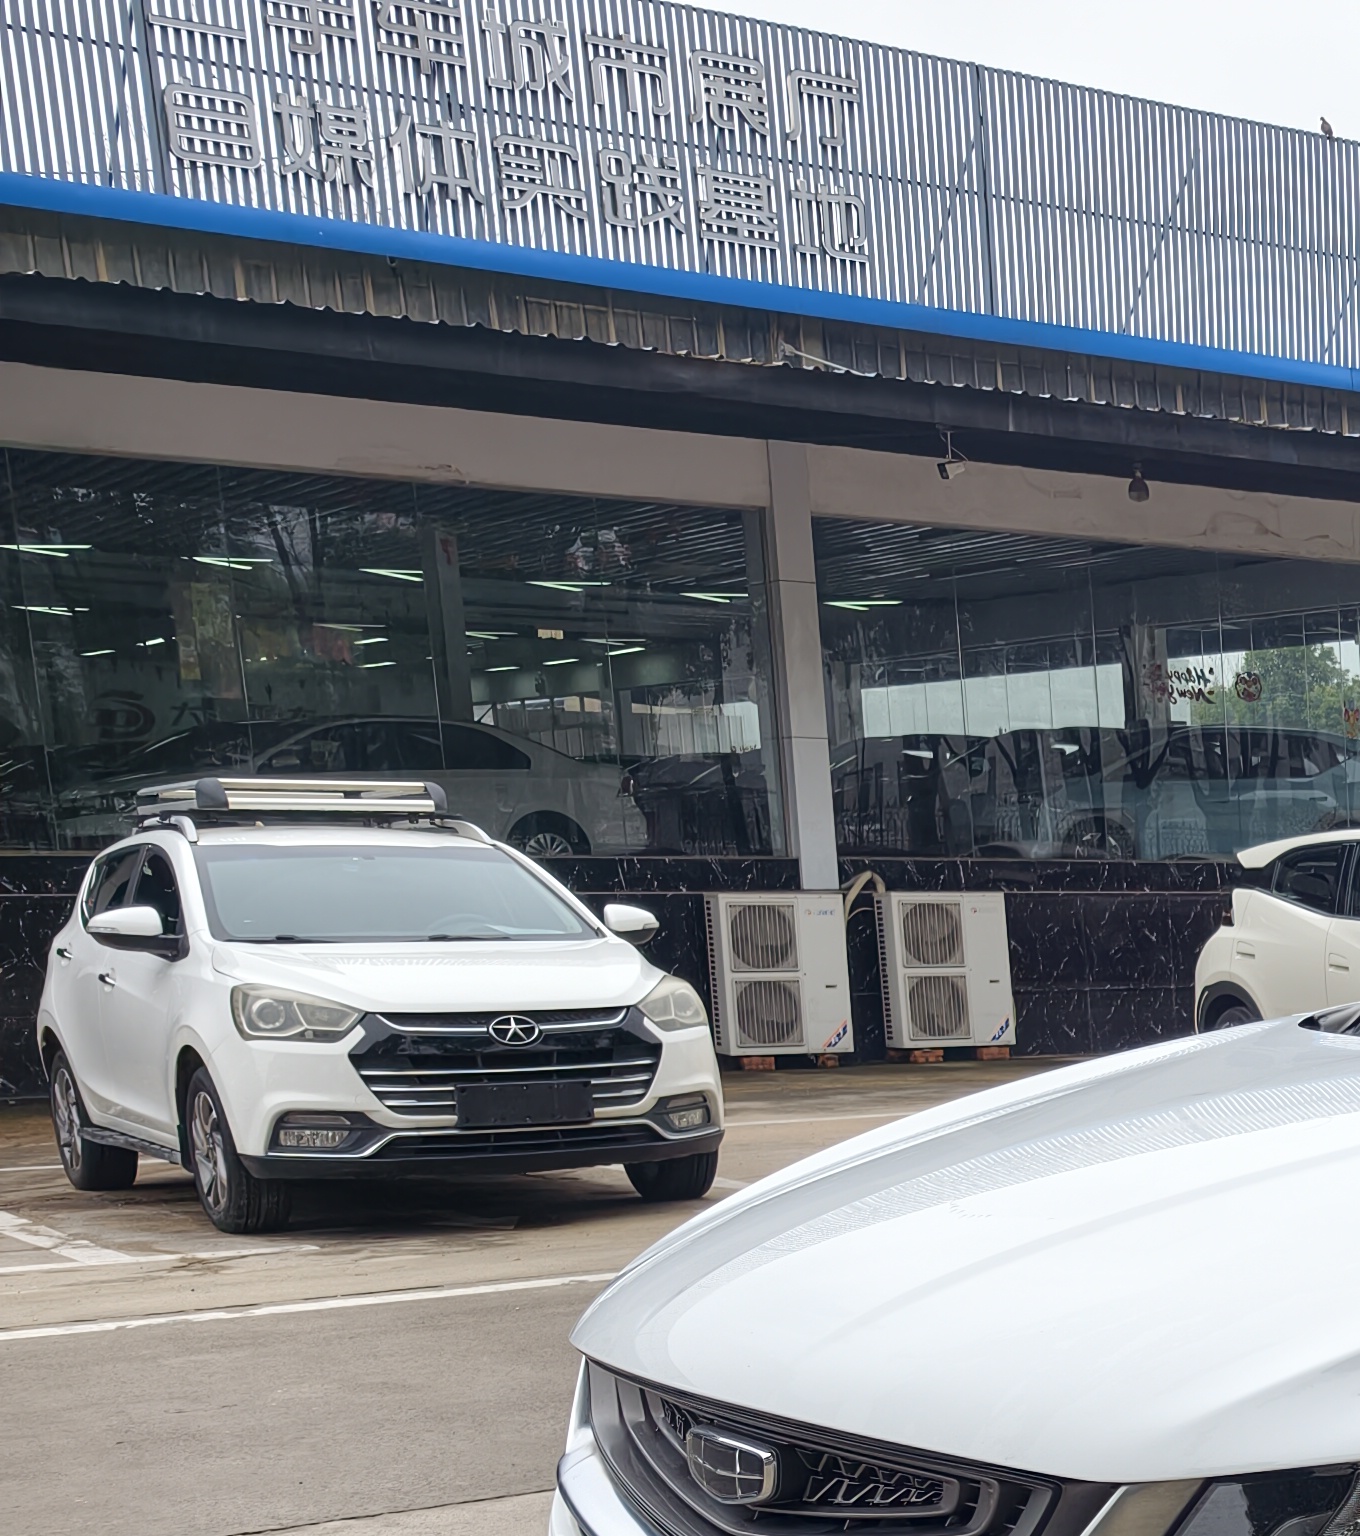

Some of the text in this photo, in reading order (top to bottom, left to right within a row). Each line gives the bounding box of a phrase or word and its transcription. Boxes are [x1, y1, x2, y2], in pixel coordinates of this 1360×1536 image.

[164, 76, 870, 263] 自媒体实践基地
